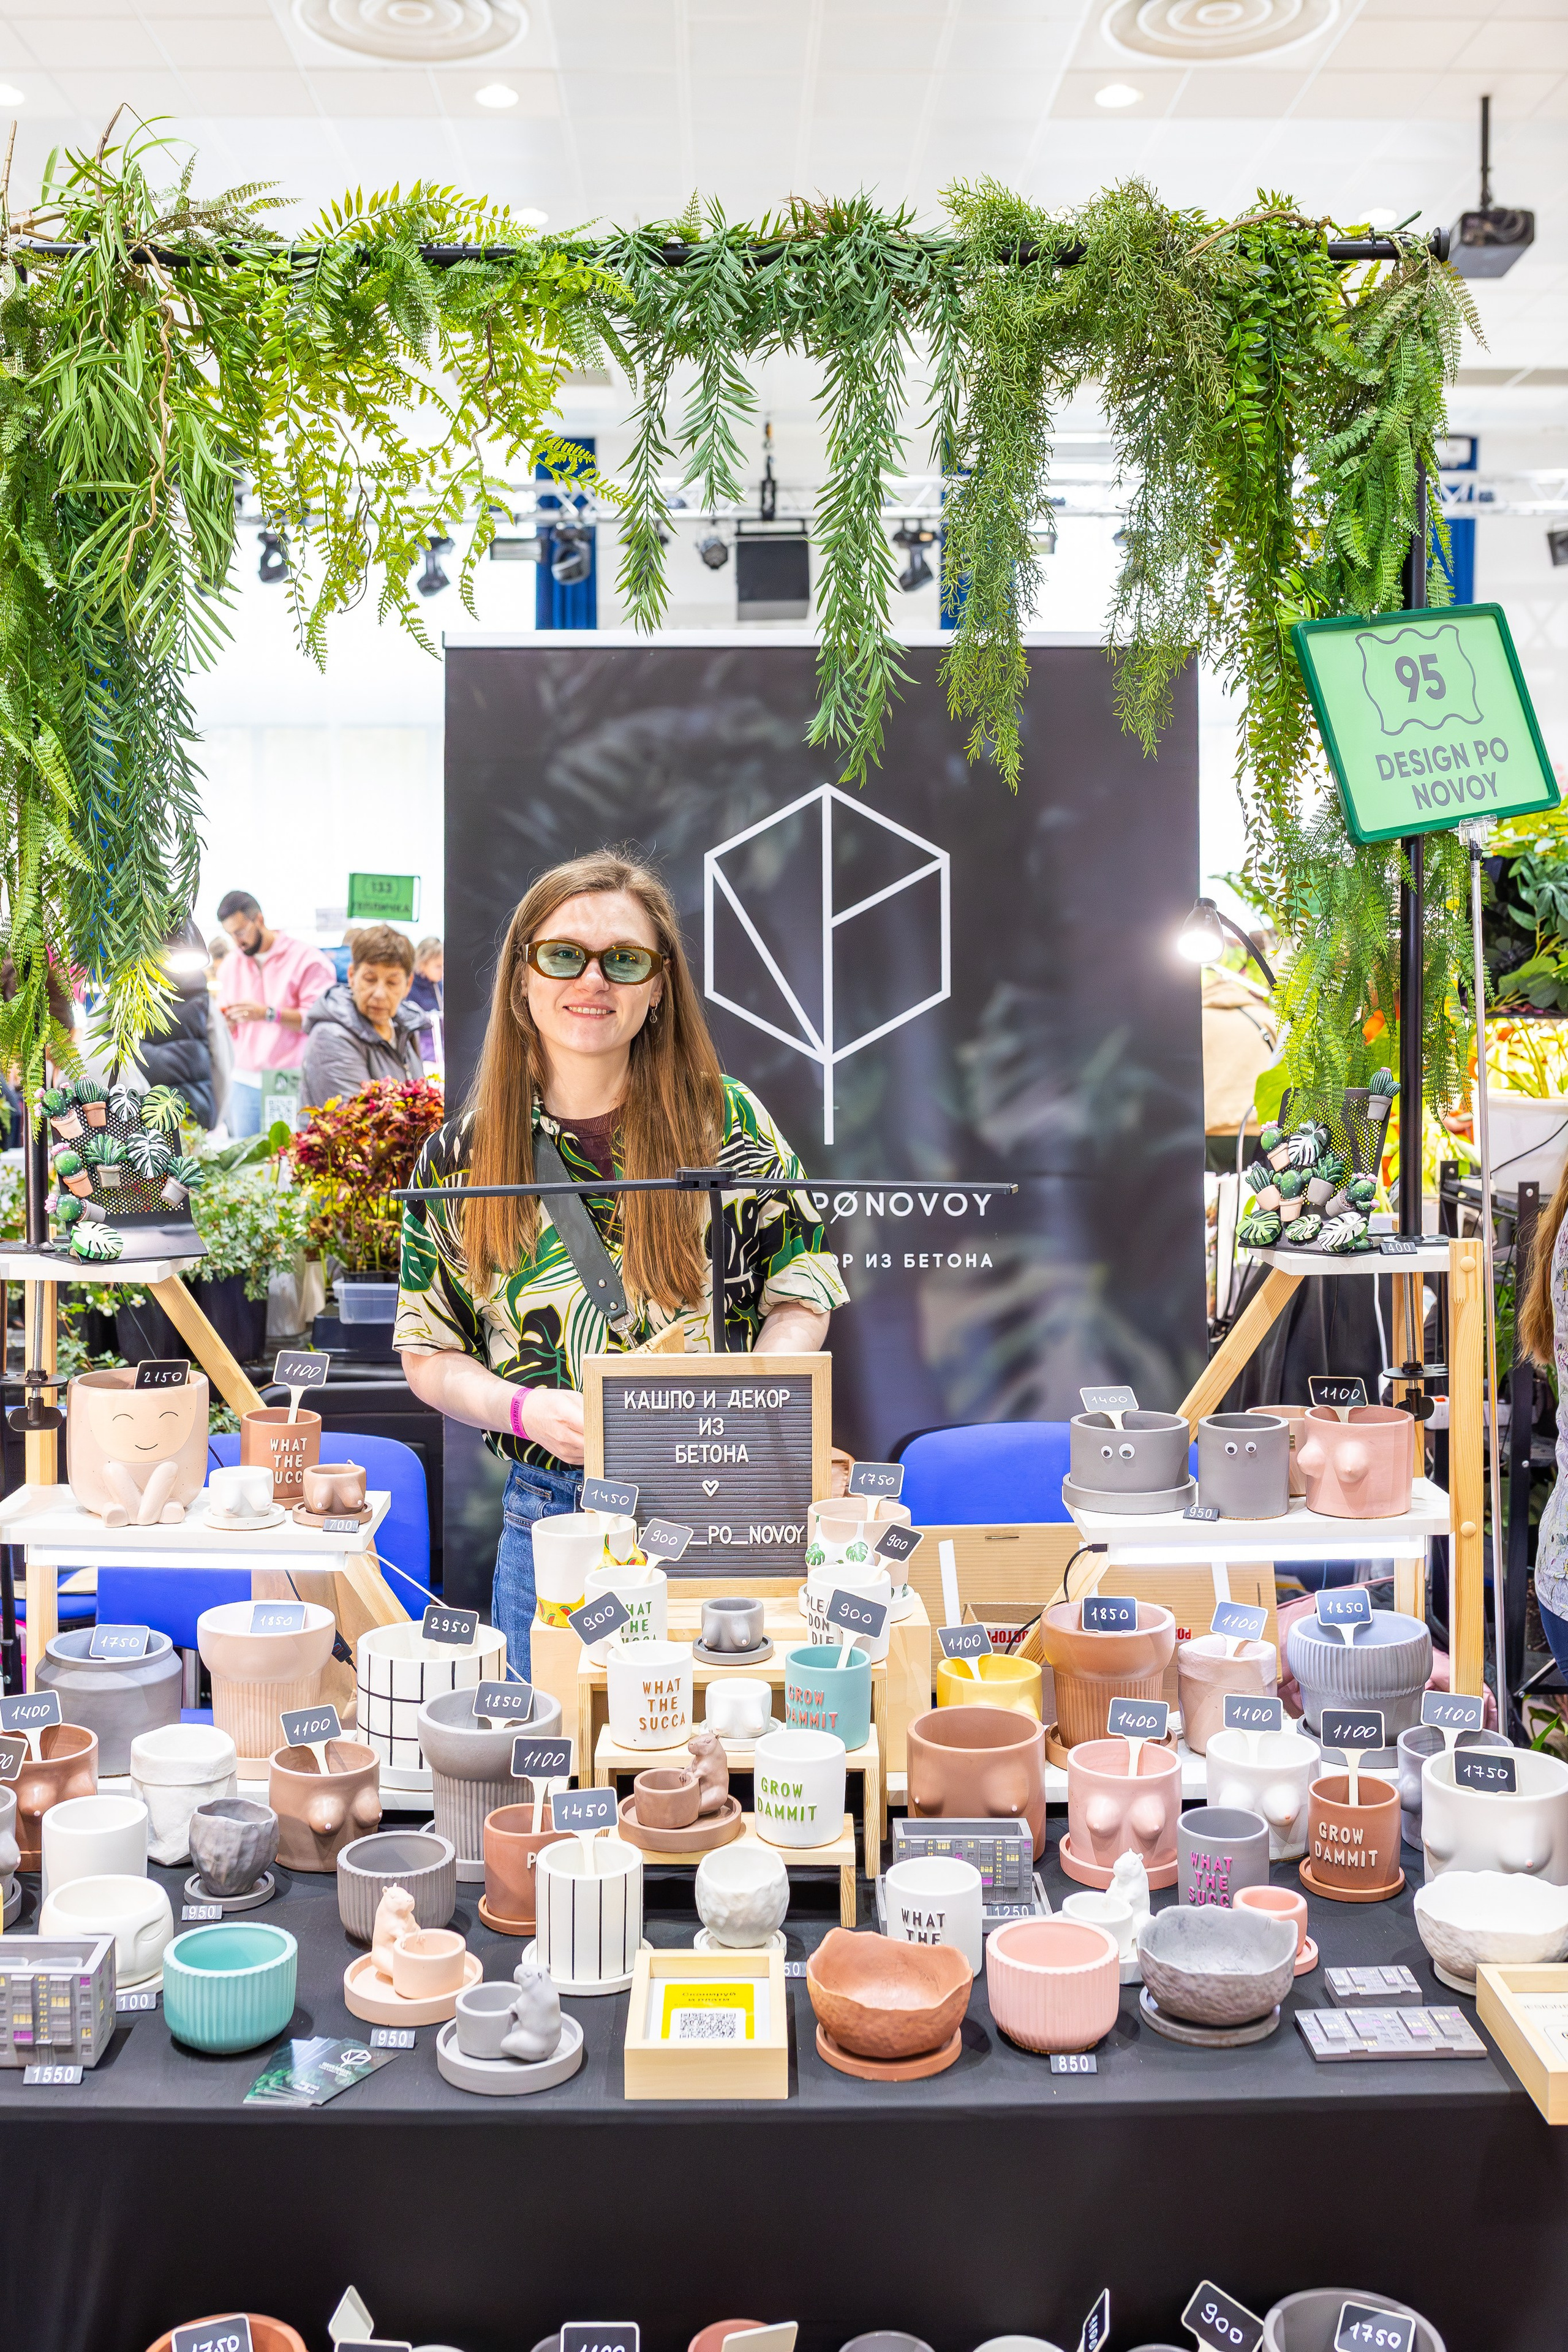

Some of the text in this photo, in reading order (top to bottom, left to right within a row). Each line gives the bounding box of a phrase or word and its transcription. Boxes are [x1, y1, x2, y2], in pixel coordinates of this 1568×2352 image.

[1395, 653, 1447, 703] 95
[1375, 737, 1509, 781] DESIGN PO
[1411, 772, 1498, 810] NOVOY
[1388, 1243, 1411, 1253] 400
[865, 1253, 892, 1268] ИЗ
[904, 1253, 993, 1268] БЕТОНА
[144, 1371, 183, 1384] 2150
[284, 1362, 322, 1379] 1100
[624, 1389, 791, 1409] КАШПО И ДЕКОР
[1090, 1394, 1128, 1404] 1400
[1320, 1387, 1360, 1401] 1100
[699, 1417, 724, 1436] ИЗ
[270, 1438, 307, 1452] WHAT
[274, 1454, 303, 1468] THE
[675, 1444, 749, 1464] БЕТОНА
[275, 1471, 303, 1484] UCC
[858, 1472, 894, 1486] 1750
[591, 1488, 629, 1506] 1450
[1188, 1507, 1213, 1518] 950
[329, 1520, 352, 1531] 700
[650, 1529, 678, 1546] 900
[886, 1534, 908, 1551] 900
[625, 1601, 652, 1616] HAT
[807, 1593, 829, 1613] PLE
[1326, 1602, 1364, 1615] 1850
[260, 1615, 293, 1627] 1850
[583, 1605, 614, 1630] 900
[838, 1602, 873, 1623] 900
[1091, 1607, 1129, 1621] 1850
[430, 1617, 470, 1634] 2950
[809, 1612, 829, 1632] DON
[1221, 1615, 1259, 1630] 1100
[100, 1635, 140, 1648] 1750
[948, 1633, 981, 1650] 1100
[643, 1677, 681, 1694] WHAT
[484, 1693, 522, 1708] 1850
[788, 1684, 824, 1706] GROW
[11, 1705, 50, 1720] 1400
[647, 1695, 678, 1713] THE
[639, 1711, 686, 1731] SUCCA
[786, 1702, 838, 1728] DAMMIT
[1117, 1712, 1158, 1729] 1400
[1232, 1705, 1273, 1723] 1100
[1433, 1705, 1476, 1722] 1100
[293, 1717, 331, 1736] 1100
[1333, 1725, 1377, 1740] 1100
[524, 1751, 565, 1768] 1100
[1463, 1763, 1509, 1779] 1750
[761, 1776, 804, 1799] GROW
[561, 1803, 608, 1820] 1450
[757, 1795, 817, 1822] DAMMIT
[1319, 1821, 1364, 1845] GROW
[1190, 1850, 1232, 1873] WHAT
[1314, 1841, 1378, 1868] DAMMIT
[1195, 1870, 1228, 1891] THE
[1188, 1886, 1229, 1907] SUCC
[189, 1905, 216, 1920] 950
[901, 1907, 945, 1928] WHAT
[994, 1905, 1029, 1917] 1250
[906, 1928, 941, 1945] THE
[378, 2030, 407, 2046] 950
[1058, 2055, 1089, 2072] 850
[32, 2066, 74, 2084] 1550
[1200, 2303, 1243, 2344] 900
[1349, 2322, 1402, 2349] 1750
